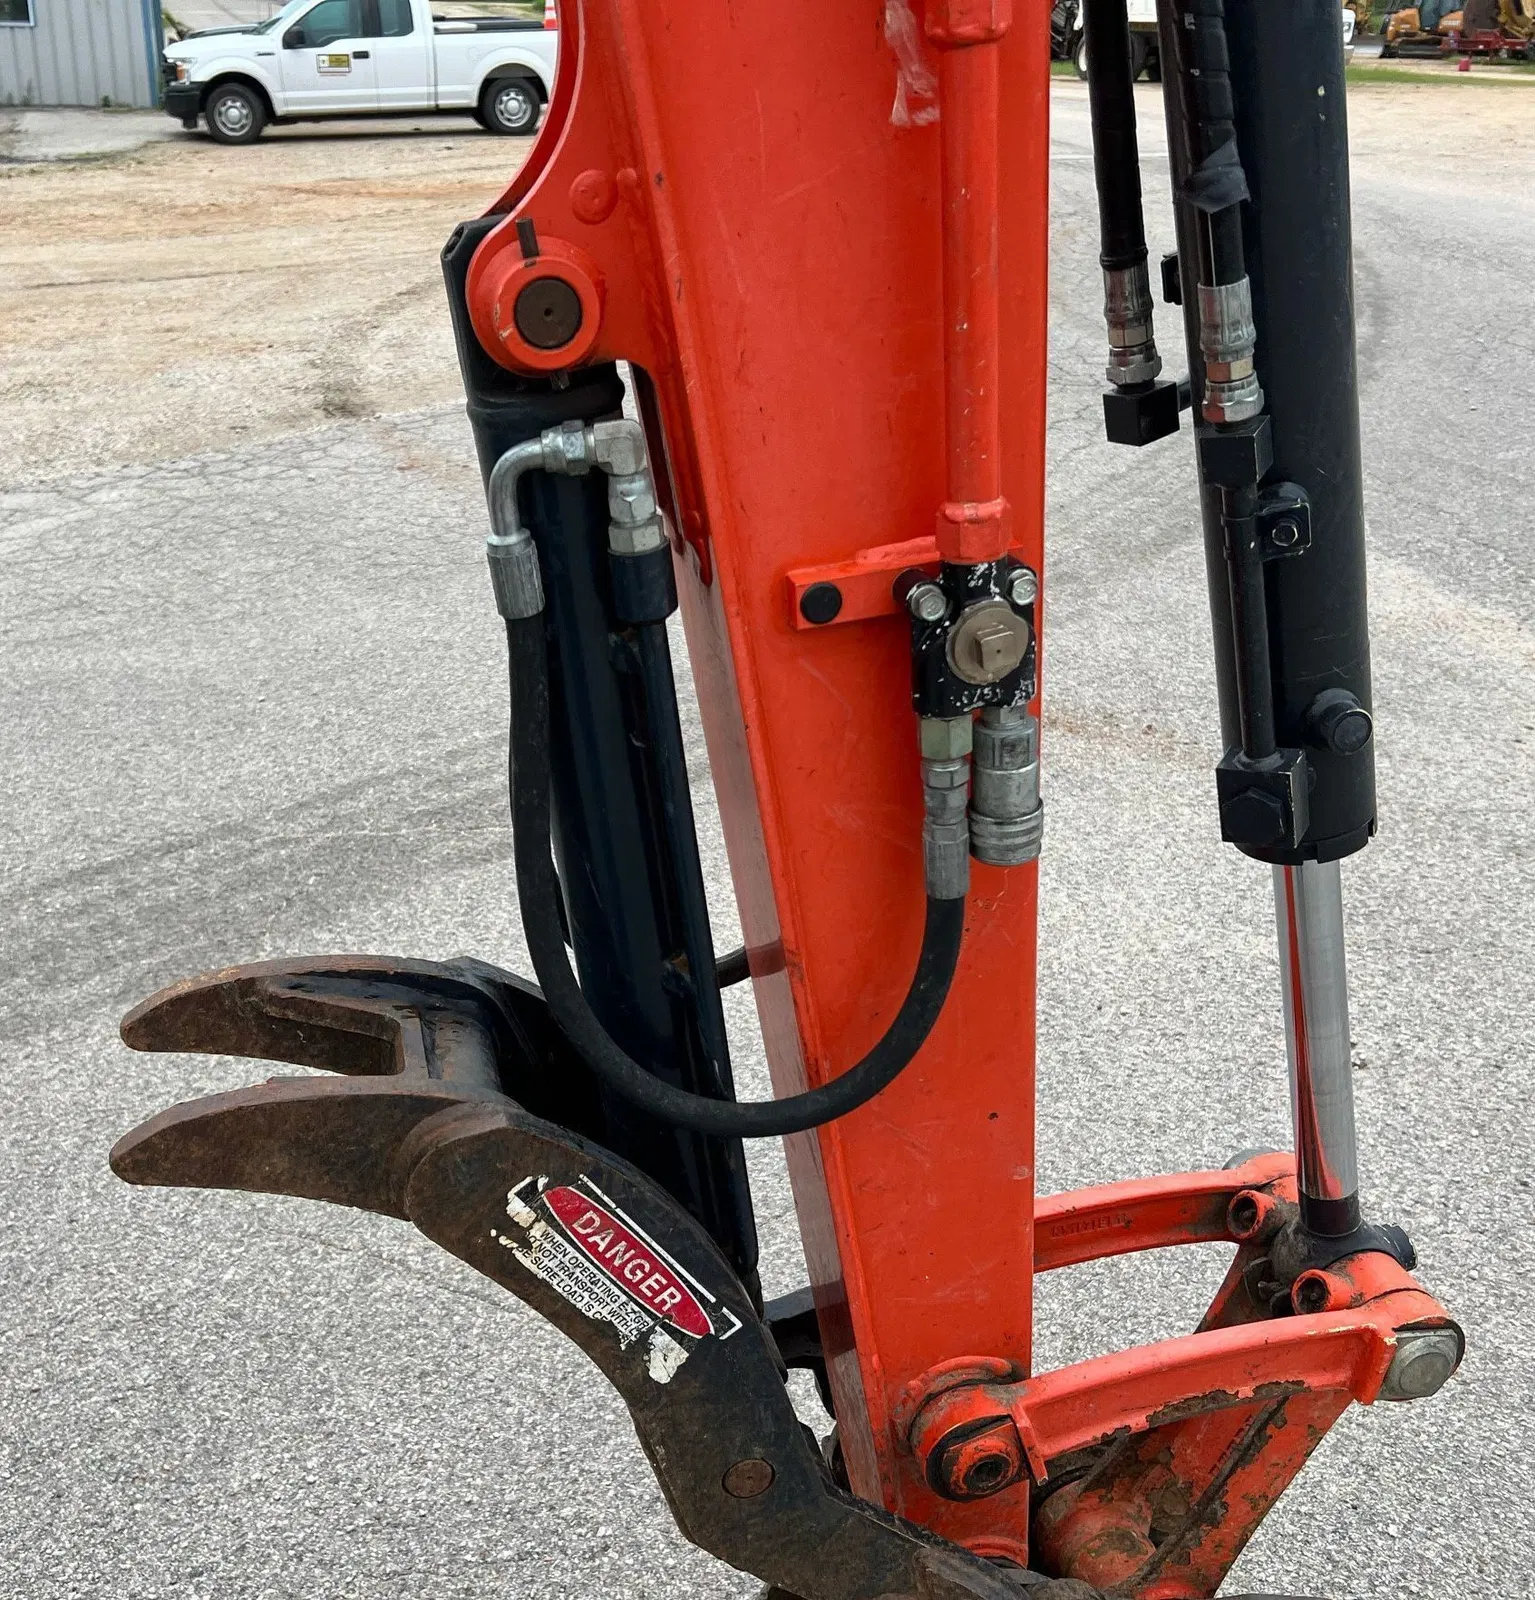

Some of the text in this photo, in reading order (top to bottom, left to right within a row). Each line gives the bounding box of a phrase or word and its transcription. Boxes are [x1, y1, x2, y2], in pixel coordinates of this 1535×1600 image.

[530, 1256, 560, 1282] SURE
[556, 1279, 584, 1303] LOAD
[583, 1301, 594, 1313] IS
[535, 1242, 558, 1262] NOT
[555, 1260, 611, 1310] TRANSPORT
[607, 1307, 632, 1331] WITH
[540, 1230, 571, 1258] WHEN
[568, 1256, 620, 1304] OPERATING
[572, 1210, 682, 1312] DANGER
